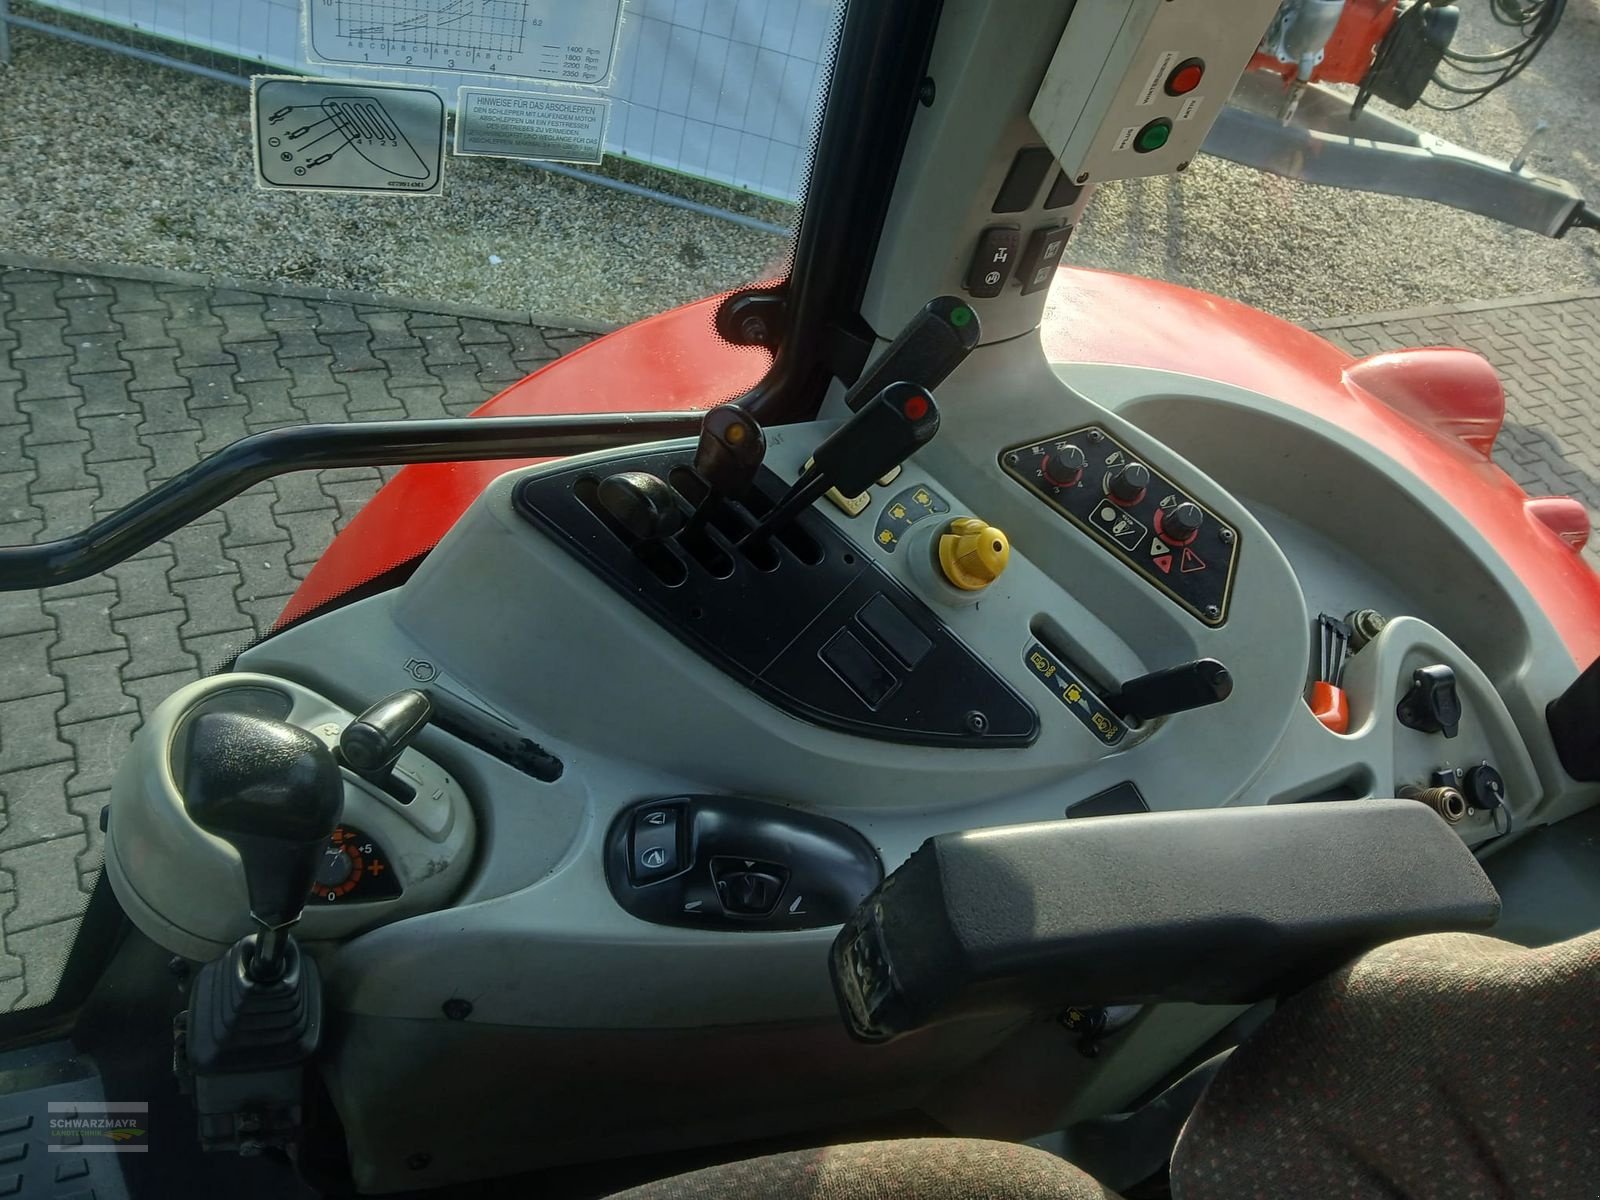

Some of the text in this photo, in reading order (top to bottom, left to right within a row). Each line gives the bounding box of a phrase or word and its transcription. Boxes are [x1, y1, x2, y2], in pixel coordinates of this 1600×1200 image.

[406, 56, 412, 64] 2
[477, 97, 595, 114] HINWEISE FÜR DAS ABSCHLEPPEN
[488, 108, 524, 116] SCHLEPPER
[537, 112, 574, 120] LAUFENDEM
[479, 115, 523, 124] ABSCHLEPPEN
[547, 120, 589, 129] FESTFRESSEN
[544, 127, 579, 135] VERMEIDEN
[328, 892, 335, 901] 0
